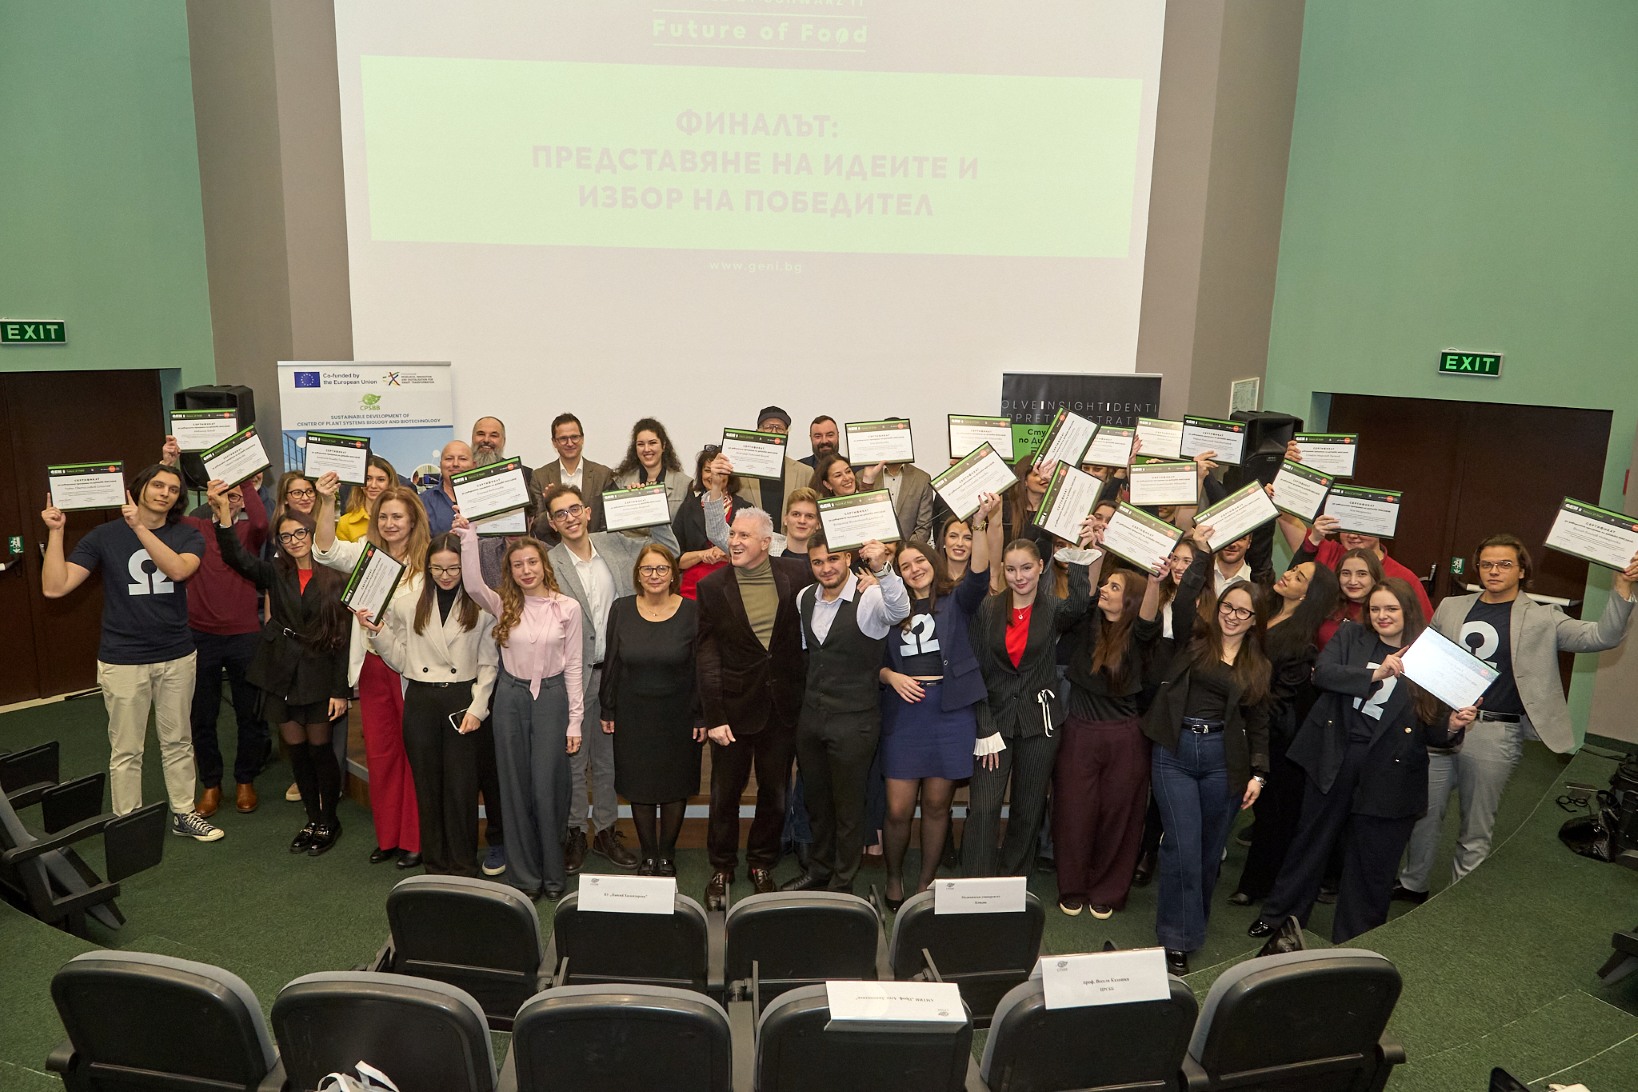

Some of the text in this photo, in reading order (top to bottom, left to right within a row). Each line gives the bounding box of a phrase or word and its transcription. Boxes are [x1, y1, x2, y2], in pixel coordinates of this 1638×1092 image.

[652, 18, 868, 44] Future of Food
[675, 108, 839, 138] ФИНАЛЪТ:
[532, 145, 978, 181] ПРЕДСТАВЯНЕ НА ИДЕИТЕ И
[579, 185, 934, 217] ИЗБОР НА ПОБЕДИТЕЛ
[709, 261, 802, 274] www.geni.bg
[7, 325, 59, 339] EXIT
[1446, 356, 1495, 371] EXIT
